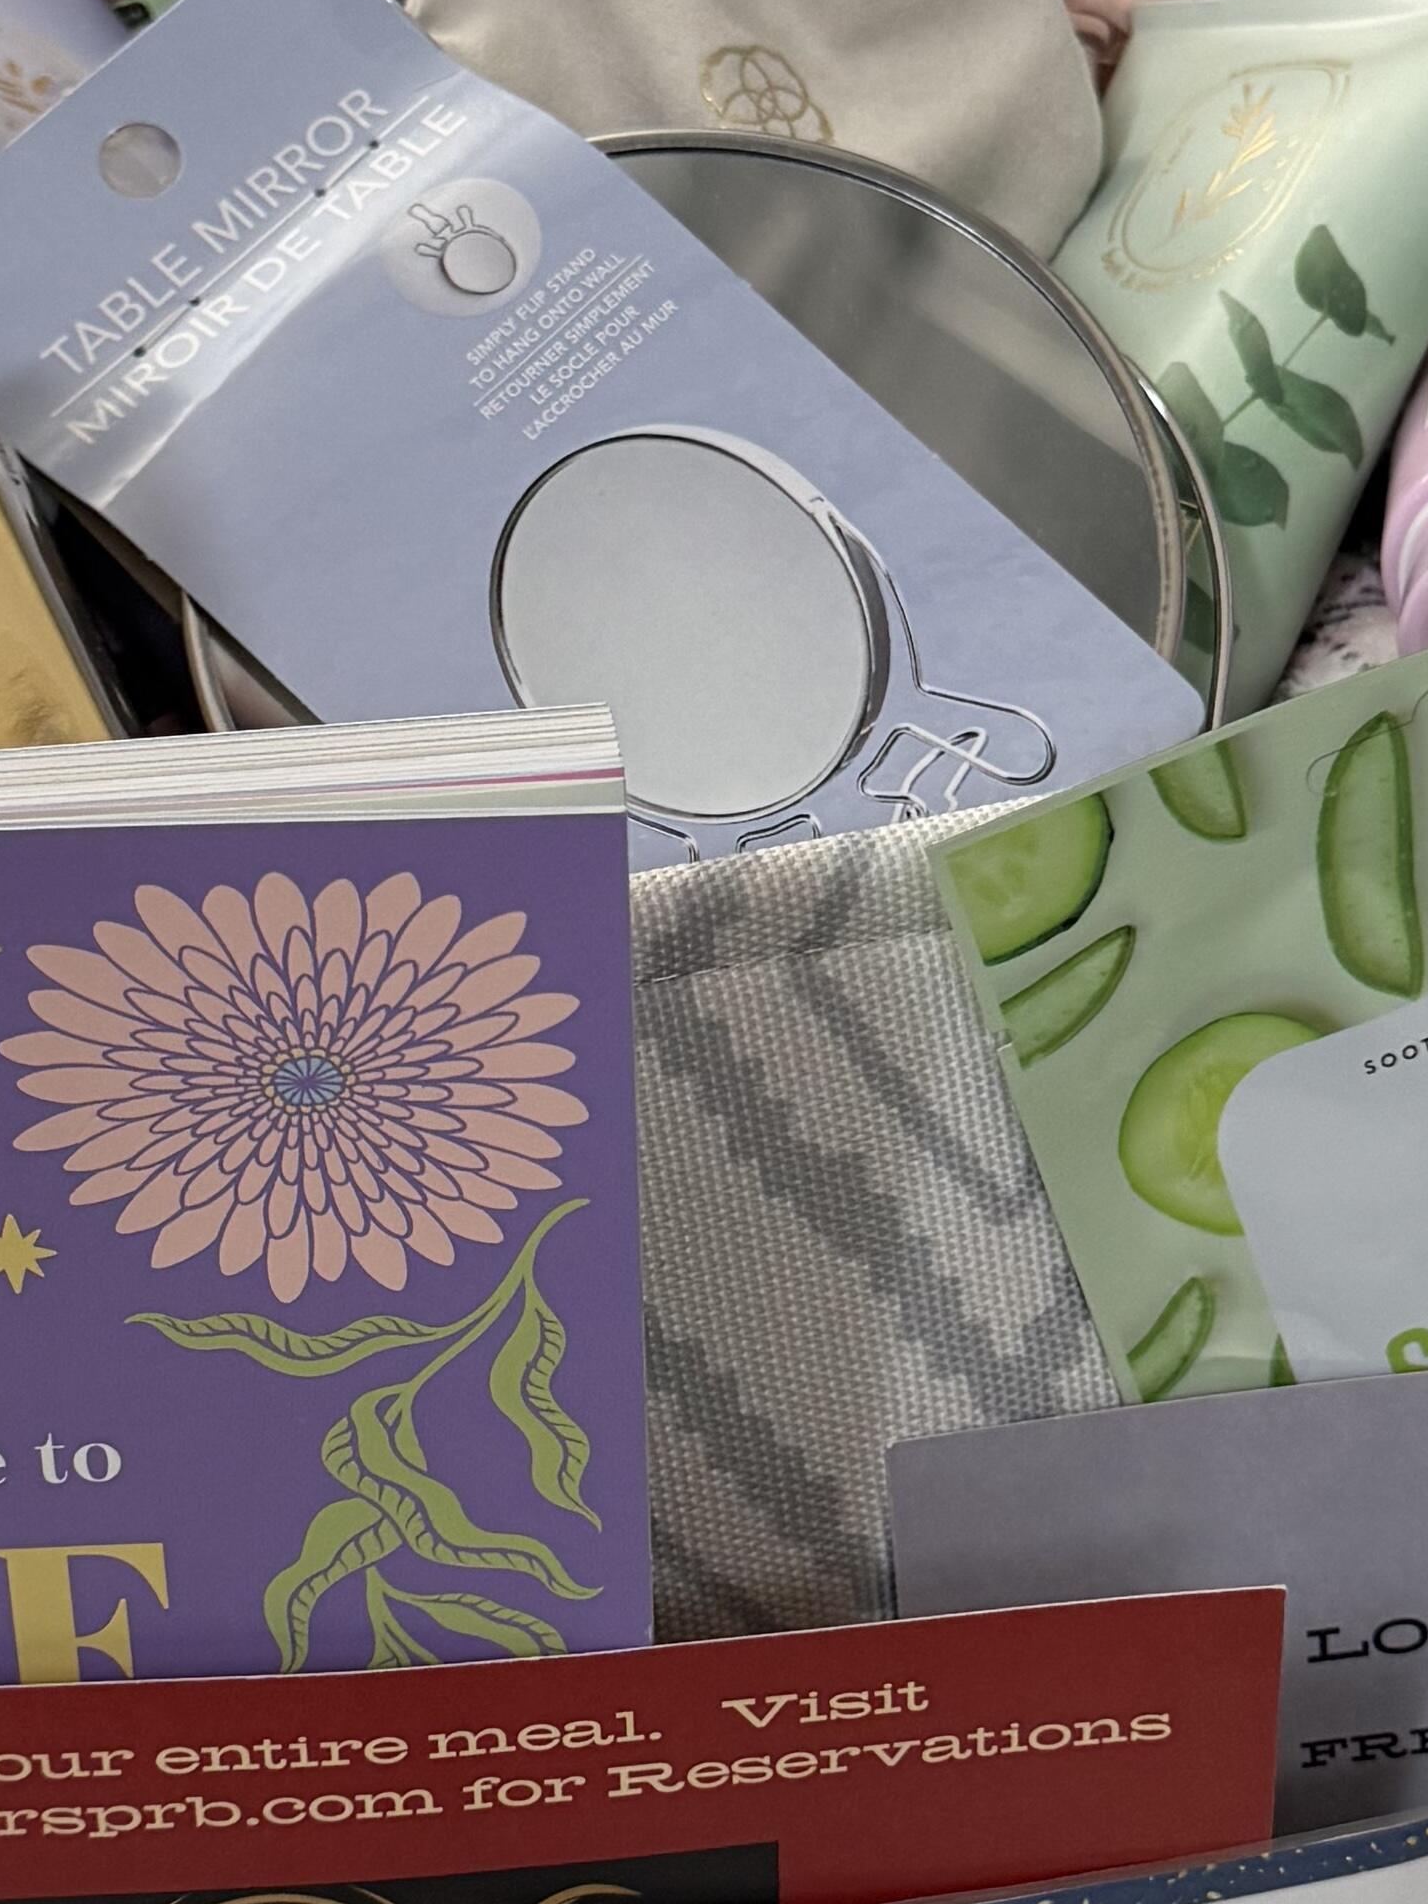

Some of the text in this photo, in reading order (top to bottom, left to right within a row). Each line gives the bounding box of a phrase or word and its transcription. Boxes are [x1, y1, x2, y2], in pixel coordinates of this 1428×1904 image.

[41, 87, 390, 375] TABLE MIRROR
[66, 102, 472, 447] MIROIR DE TABLE
[466, 248, 597, 366] SIMPLY FLIP STAND
[469, 253, 626, 390] TO HANG ONTO WALL
[479, 260, 656, 421] RETOURNER SIMPLEMENT
[522, 299, 680, 441] L'ACCROCHER AU MUR
[529, 304, 641, 406] LE SOCLE POUR
[36, 1428, 125, 1487] to
[154, 1726, 410, 1780] entire
[425, 1707, 663, 1761] meal.
[721, 1678, 932, 1732] Visit
[460, 1772, 588, 1812] for
[606, 1709, 1174, 1801] Reservations
